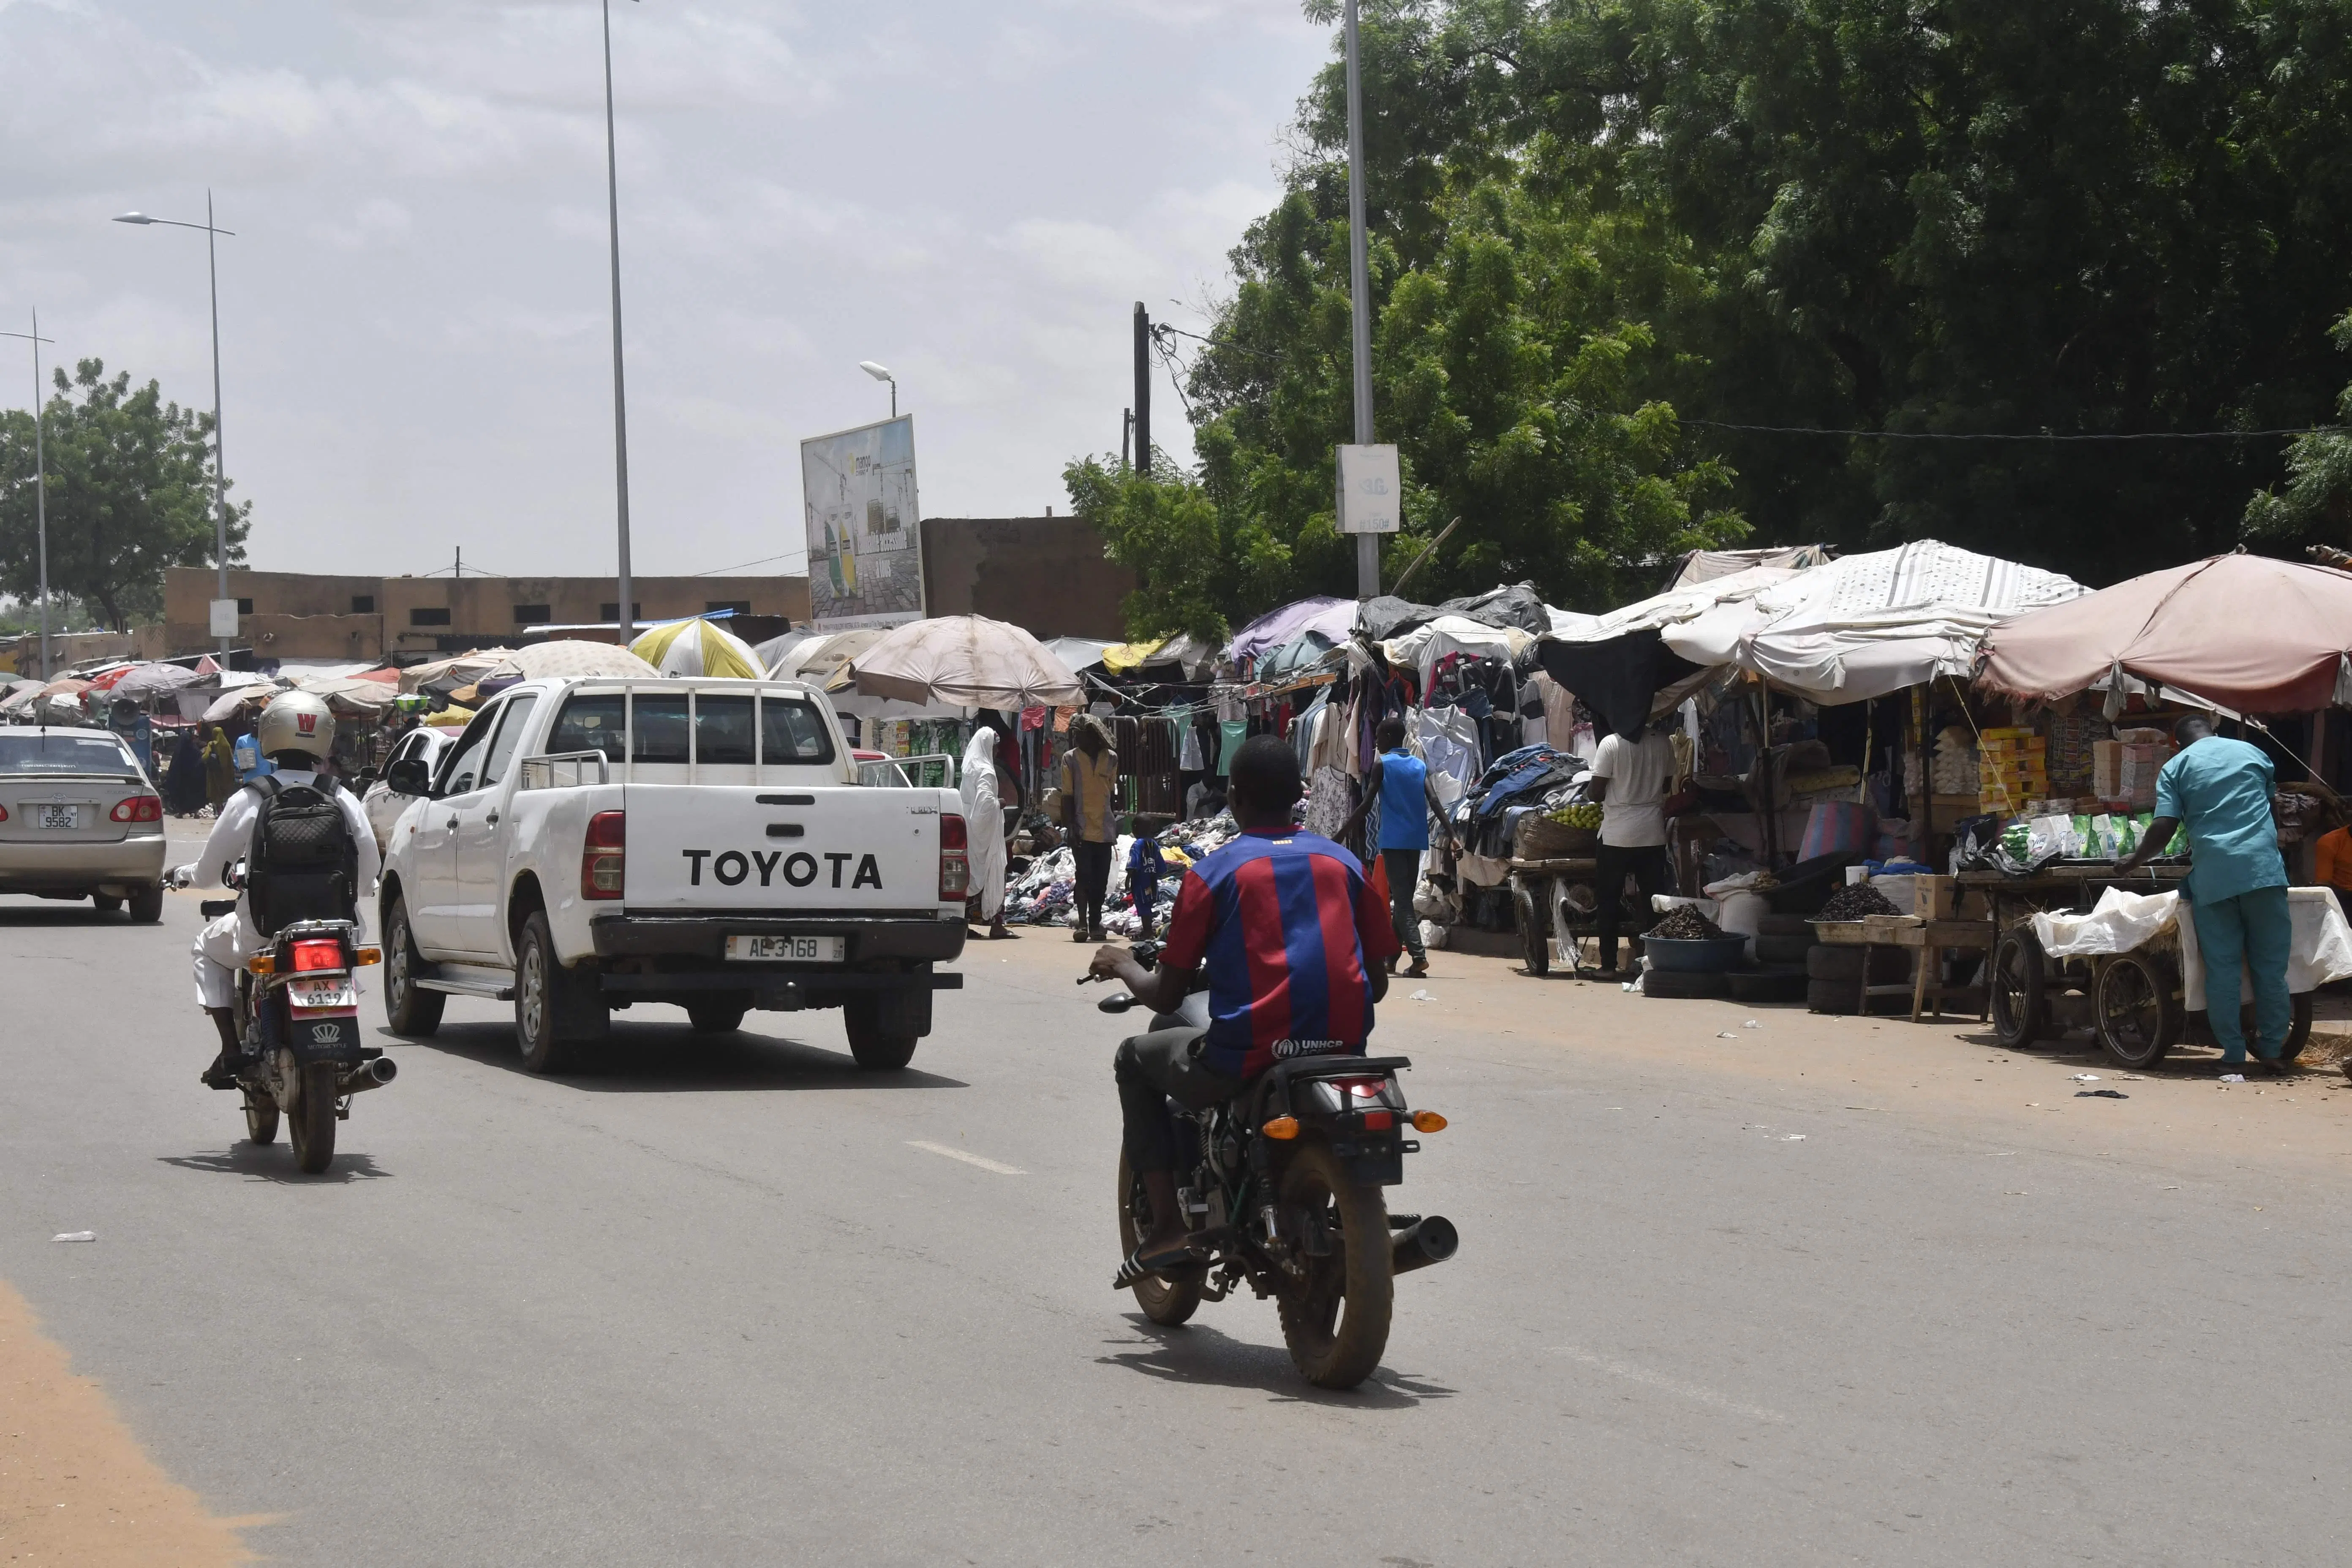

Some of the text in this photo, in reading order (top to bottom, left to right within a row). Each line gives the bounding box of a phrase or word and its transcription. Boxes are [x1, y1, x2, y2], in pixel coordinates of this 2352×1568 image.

[879, 527, 907, 552] accessible
[52, 806, 65, 817] BK
[46, 817, 71, 828] 9582
[682, 849, 883, 890] TOYOTA
[314, 981, 331, 991] AX
[307, 993, 341, 1004] 6119
